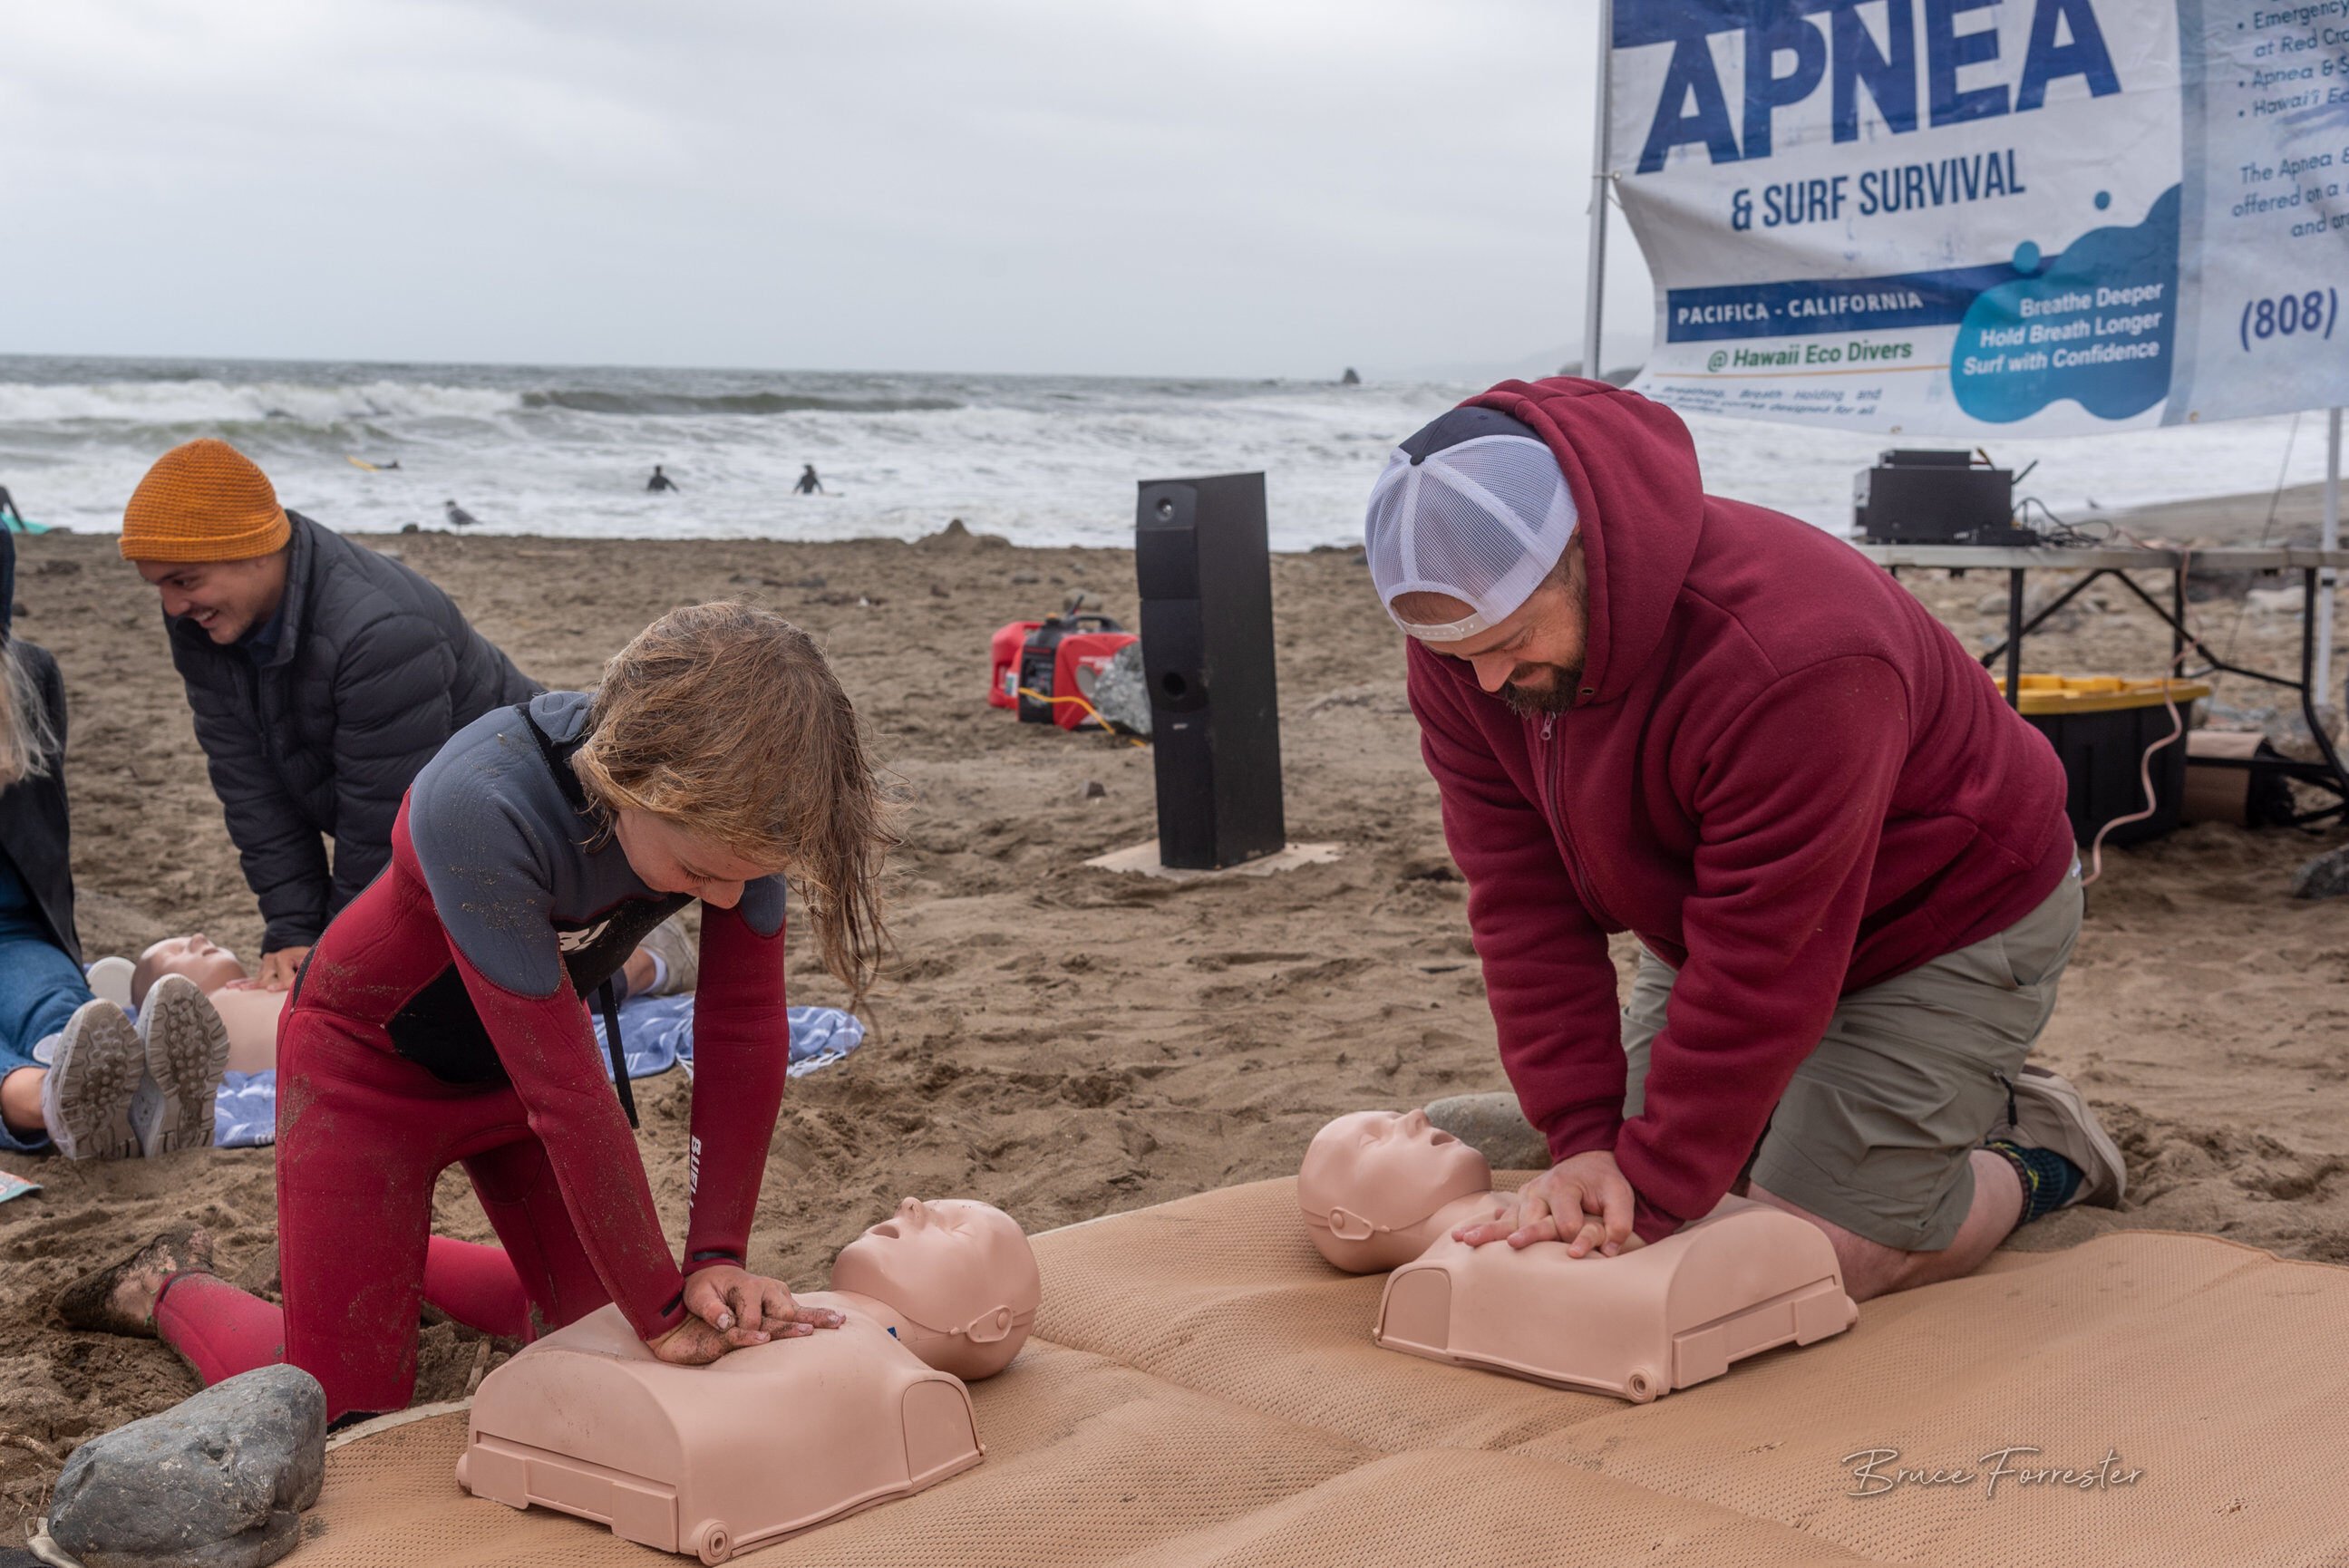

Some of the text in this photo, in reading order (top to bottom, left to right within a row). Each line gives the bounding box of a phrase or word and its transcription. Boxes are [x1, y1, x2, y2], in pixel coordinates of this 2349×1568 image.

[2254, 39, 2275, 57] at
[2280, 28, 2318, 53] Red
[1635, 0, 2122, 175] APNEA
[2252, 67, 2314, 91] Apnea
[2322, 59, 2334, 76] &
[2240, 161, 2274, 185] The
[2277, 153, 2333, 181] Apnea
[1732, 149, 2026, 232] & SURF SURVIVAL
[2232, 183, 2338, 217] offered on a
[2291, 209, 2327, 237] and
[1677, 302, 1770, 326] PACIFICA
[1788, 291, 1924, 317] CALIFORNIA
[2020, 283, 2165, 317] Breathe Deeper
[1980, 312, 2163, 348] Hold Breath Longer
[2240, 286, 2338, 353] (808)
[1707, 339, 1913, 373] @ Hawaii Eco Divers
[1963, 341, 2160, 376] Surf with Confidence
